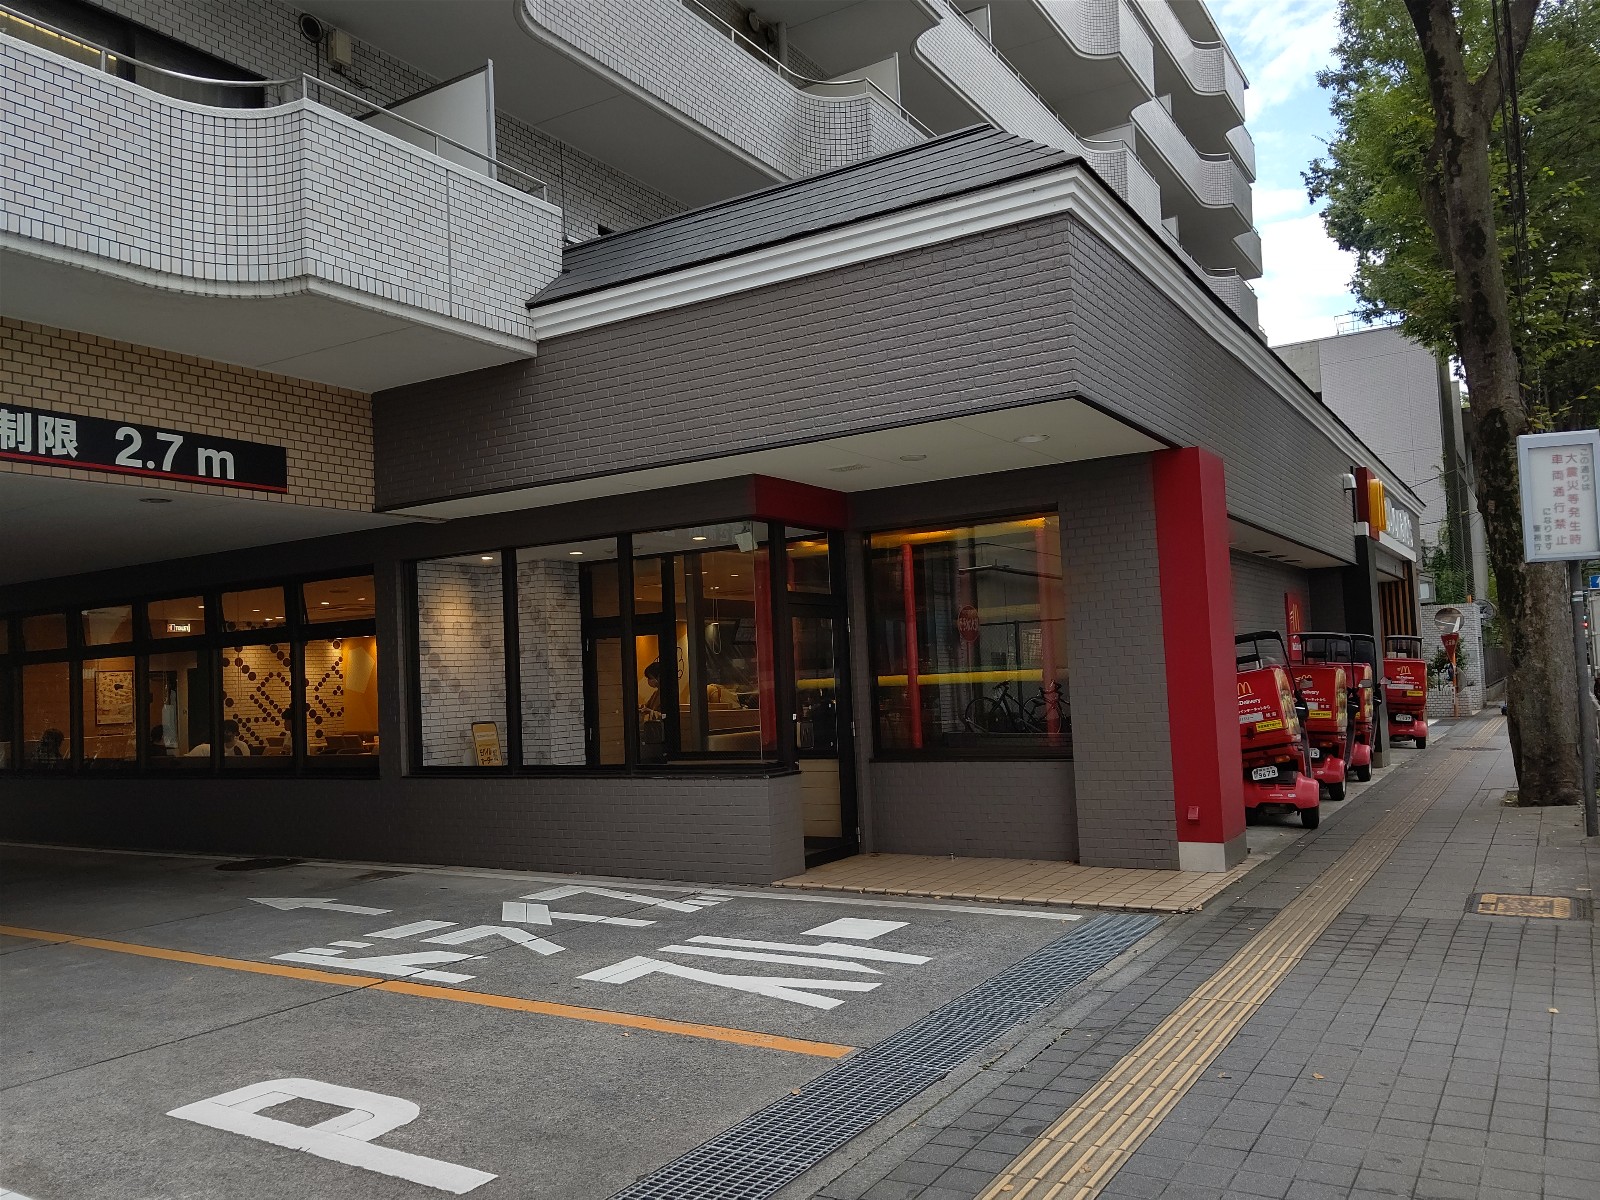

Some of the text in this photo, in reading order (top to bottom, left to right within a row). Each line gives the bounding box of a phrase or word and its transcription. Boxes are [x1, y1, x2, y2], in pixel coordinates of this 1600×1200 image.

[0, 408, 236, 480] 制限 2.7 m
[1551, 454, 1568, 546] 車両通行禁止
[165, 1077, 499, 1195] P
